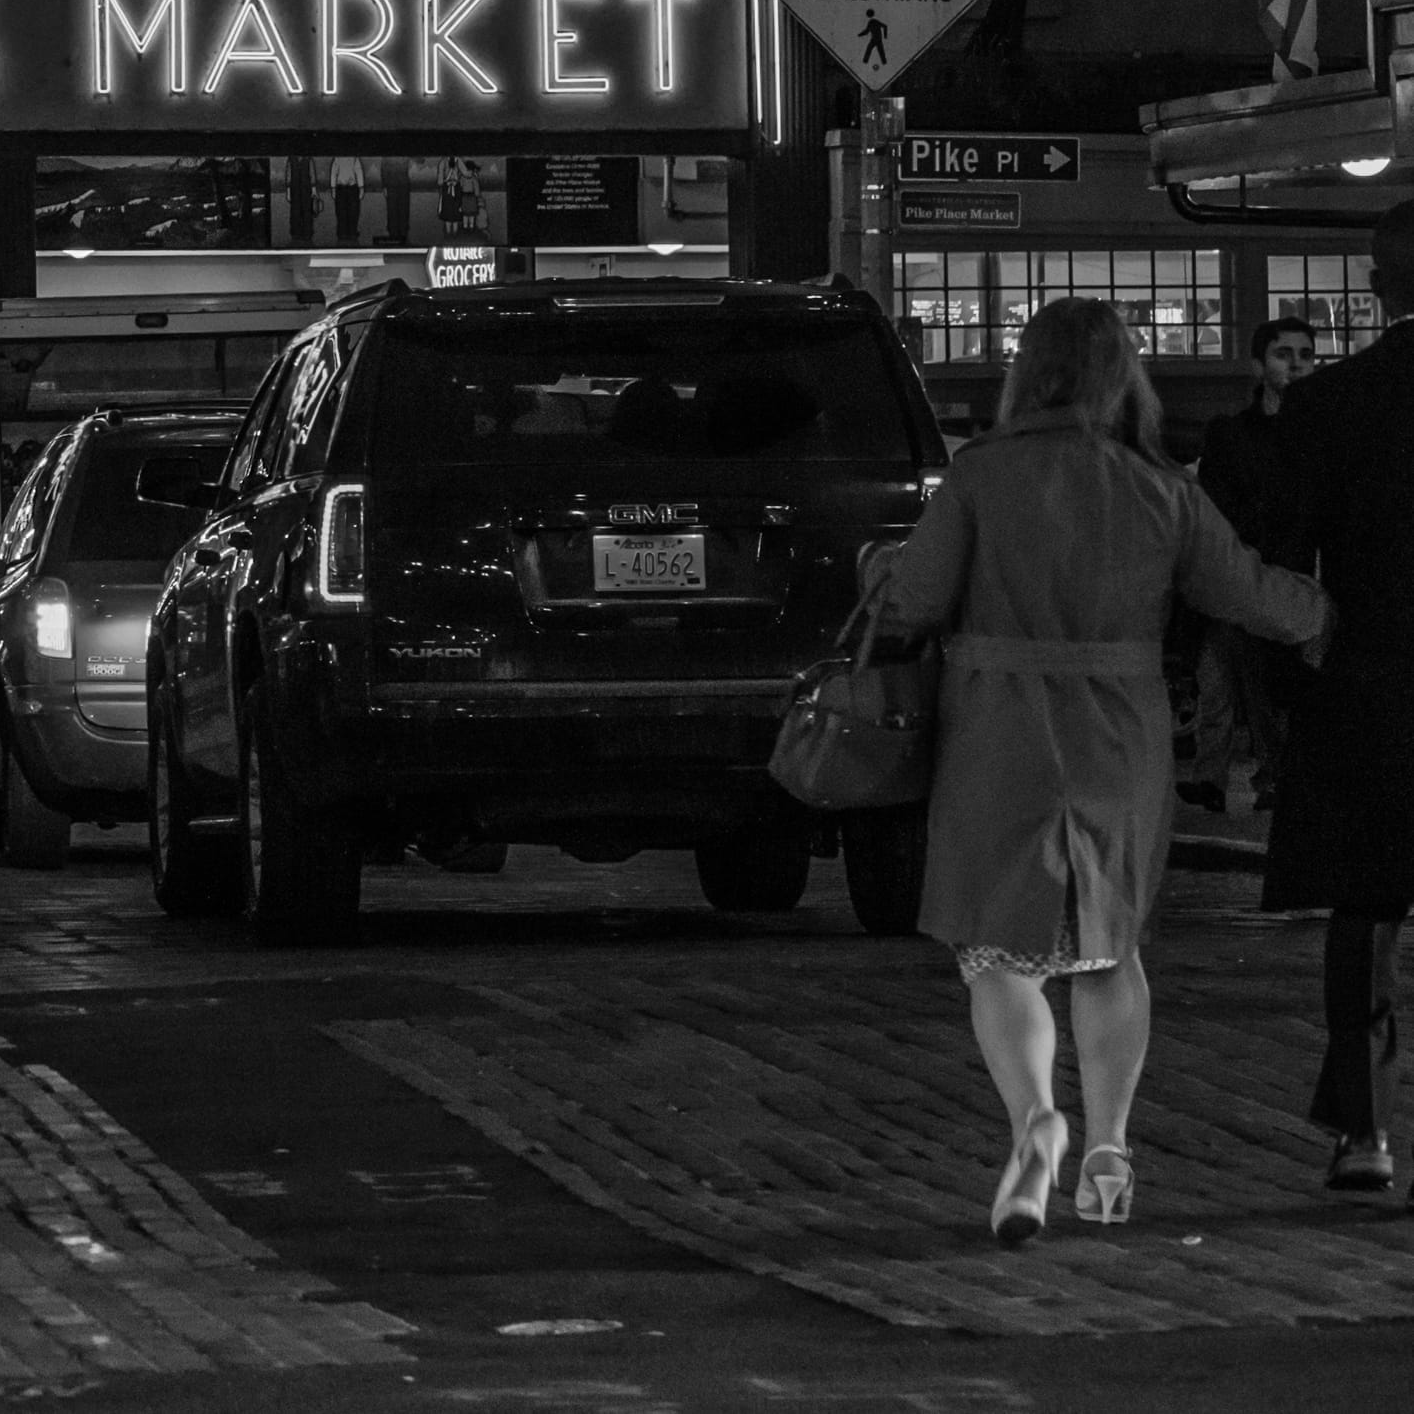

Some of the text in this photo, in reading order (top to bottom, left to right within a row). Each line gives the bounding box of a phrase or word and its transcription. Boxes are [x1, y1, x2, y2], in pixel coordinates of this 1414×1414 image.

[911, 139, 1019, 174] Pike Pl
[905, 207, 1015, 221] Pike Place Market
[436, 263, 496, 288] GROCERY
[608, 503, 699, 525] GMC
[388, 647, 482, 659] YUKON
